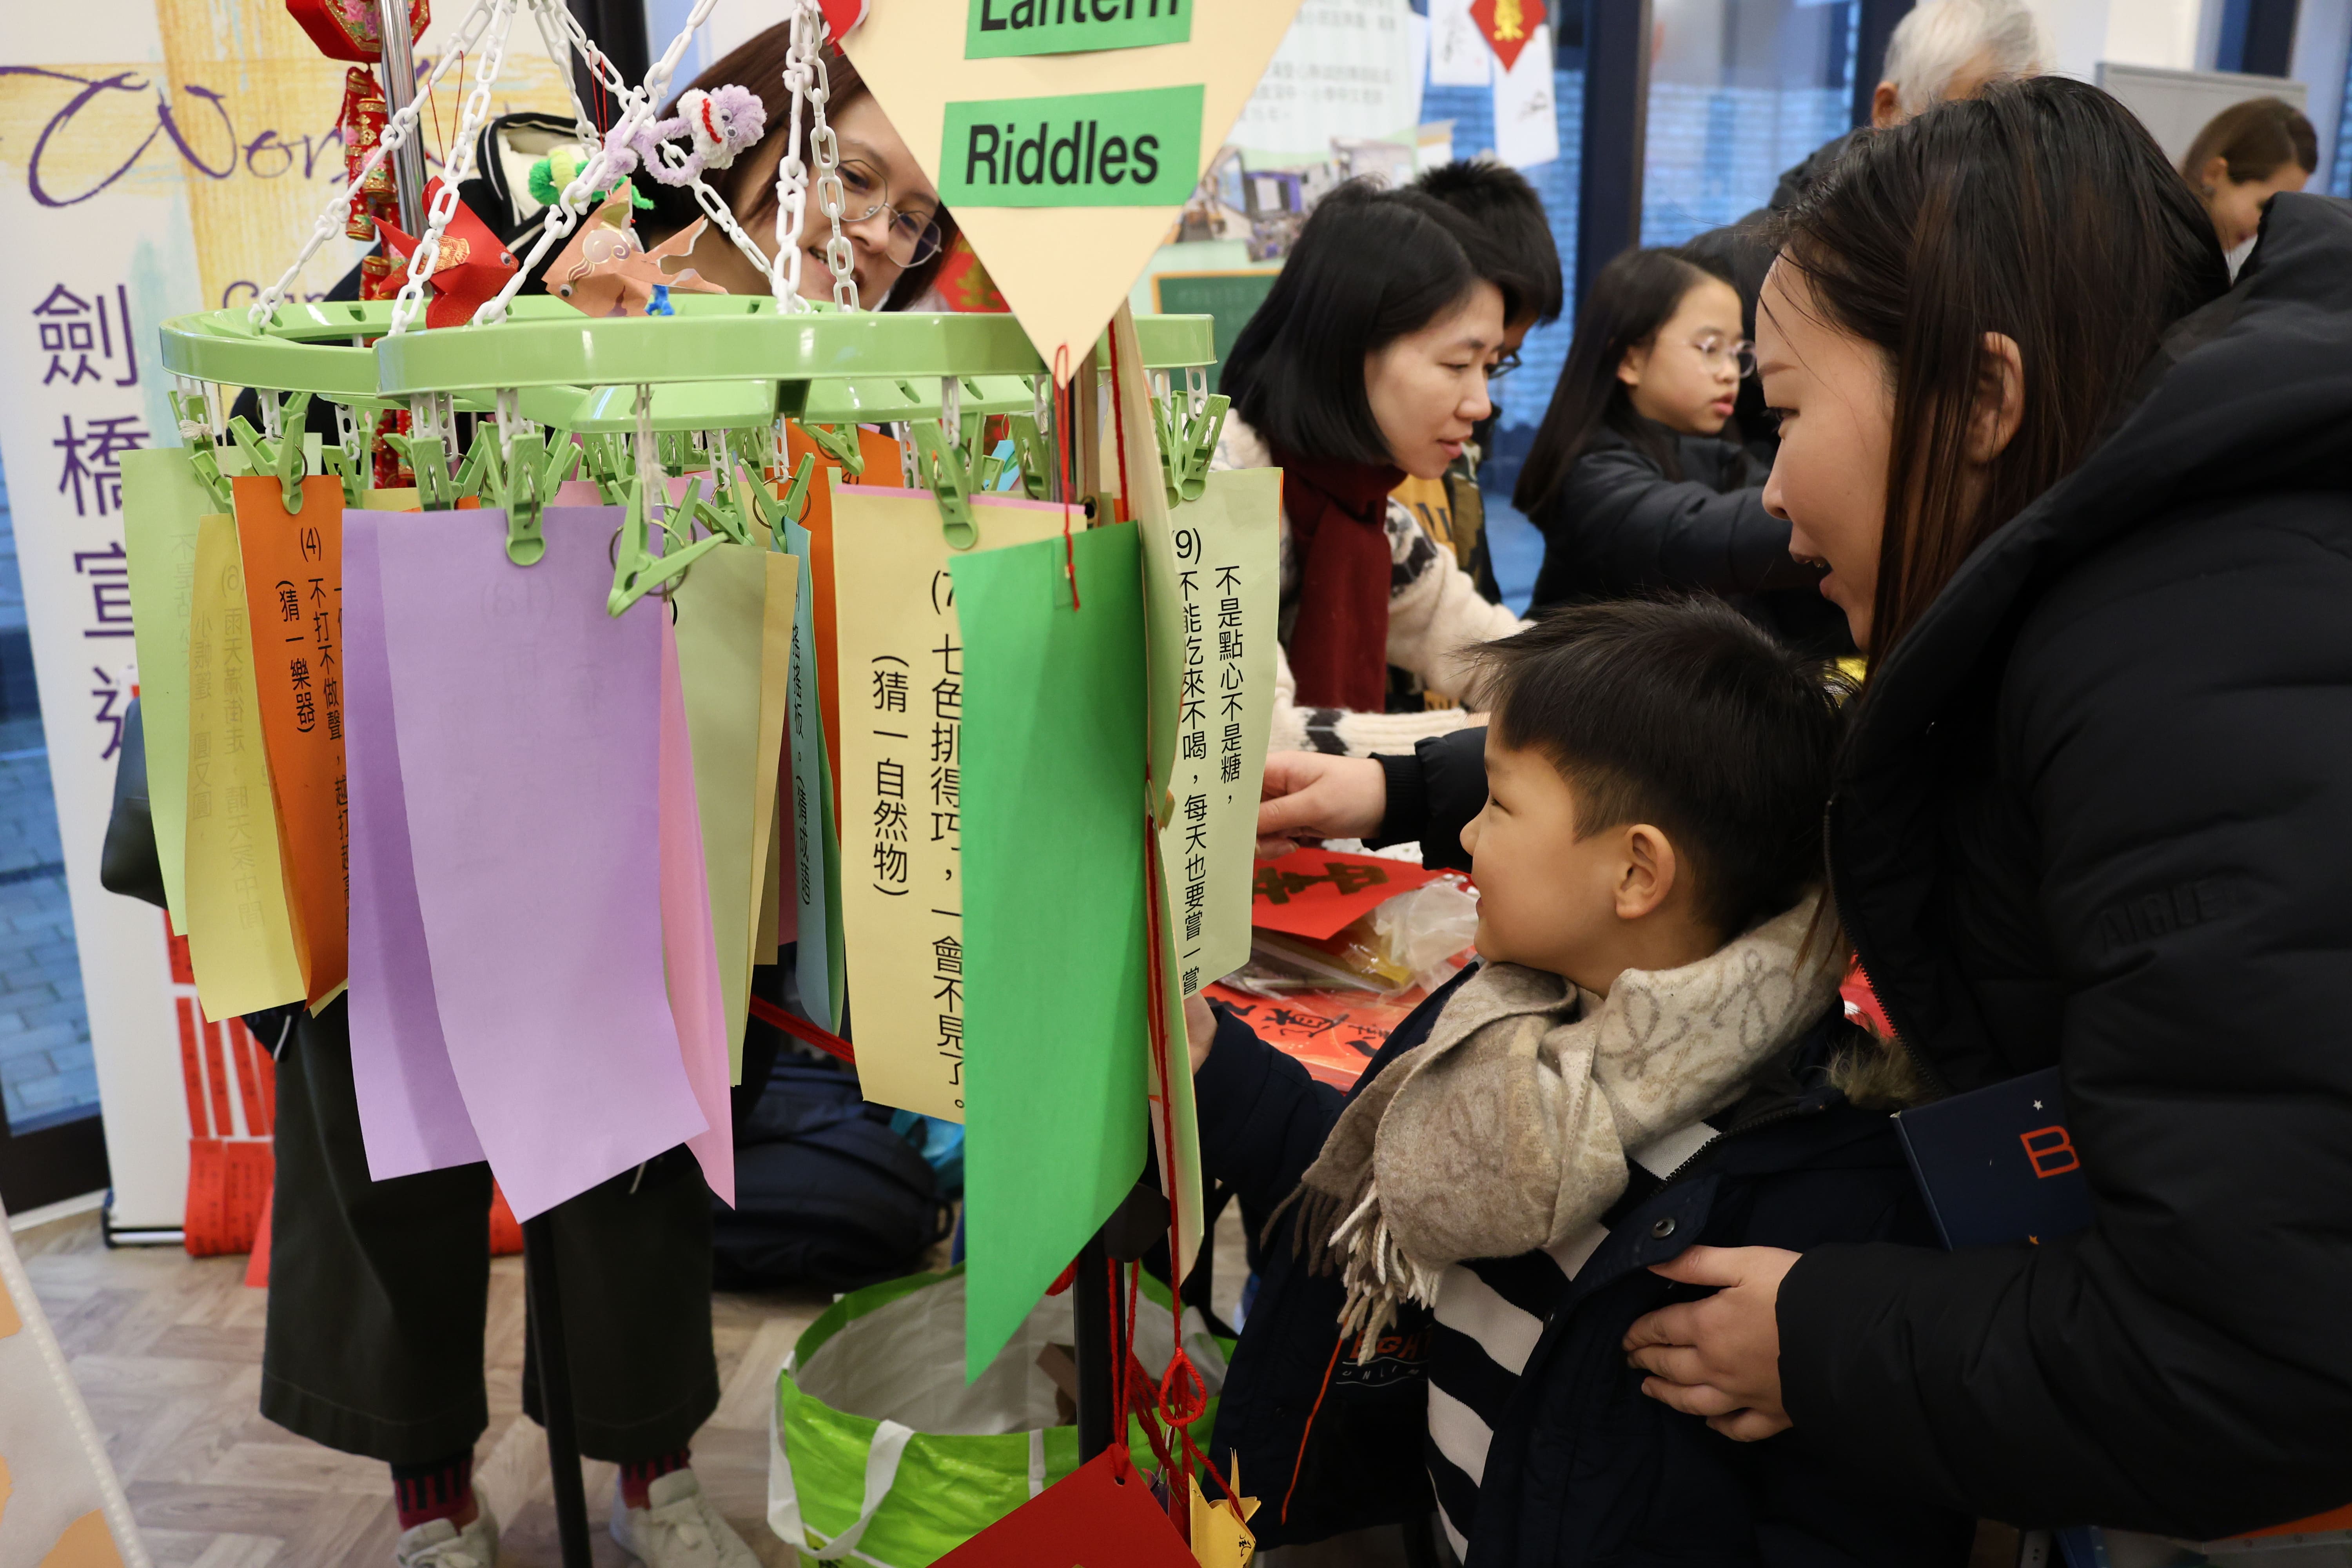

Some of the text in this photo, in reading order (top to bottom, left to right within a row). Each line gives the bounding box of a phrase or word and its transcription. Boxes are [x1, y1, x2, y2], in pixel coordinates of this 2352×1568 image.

[965, 120, 1159, 185] Riddles
[300, 526, 321, 562] (4)
[1171, 528, 1201, 564] 9)
[276, 581, 316, 733] (猜一樂器)
[1215, 565, 1244, 804] 不是點心不是糖，
[871, 655, 909, 896] (猜一自然物)
